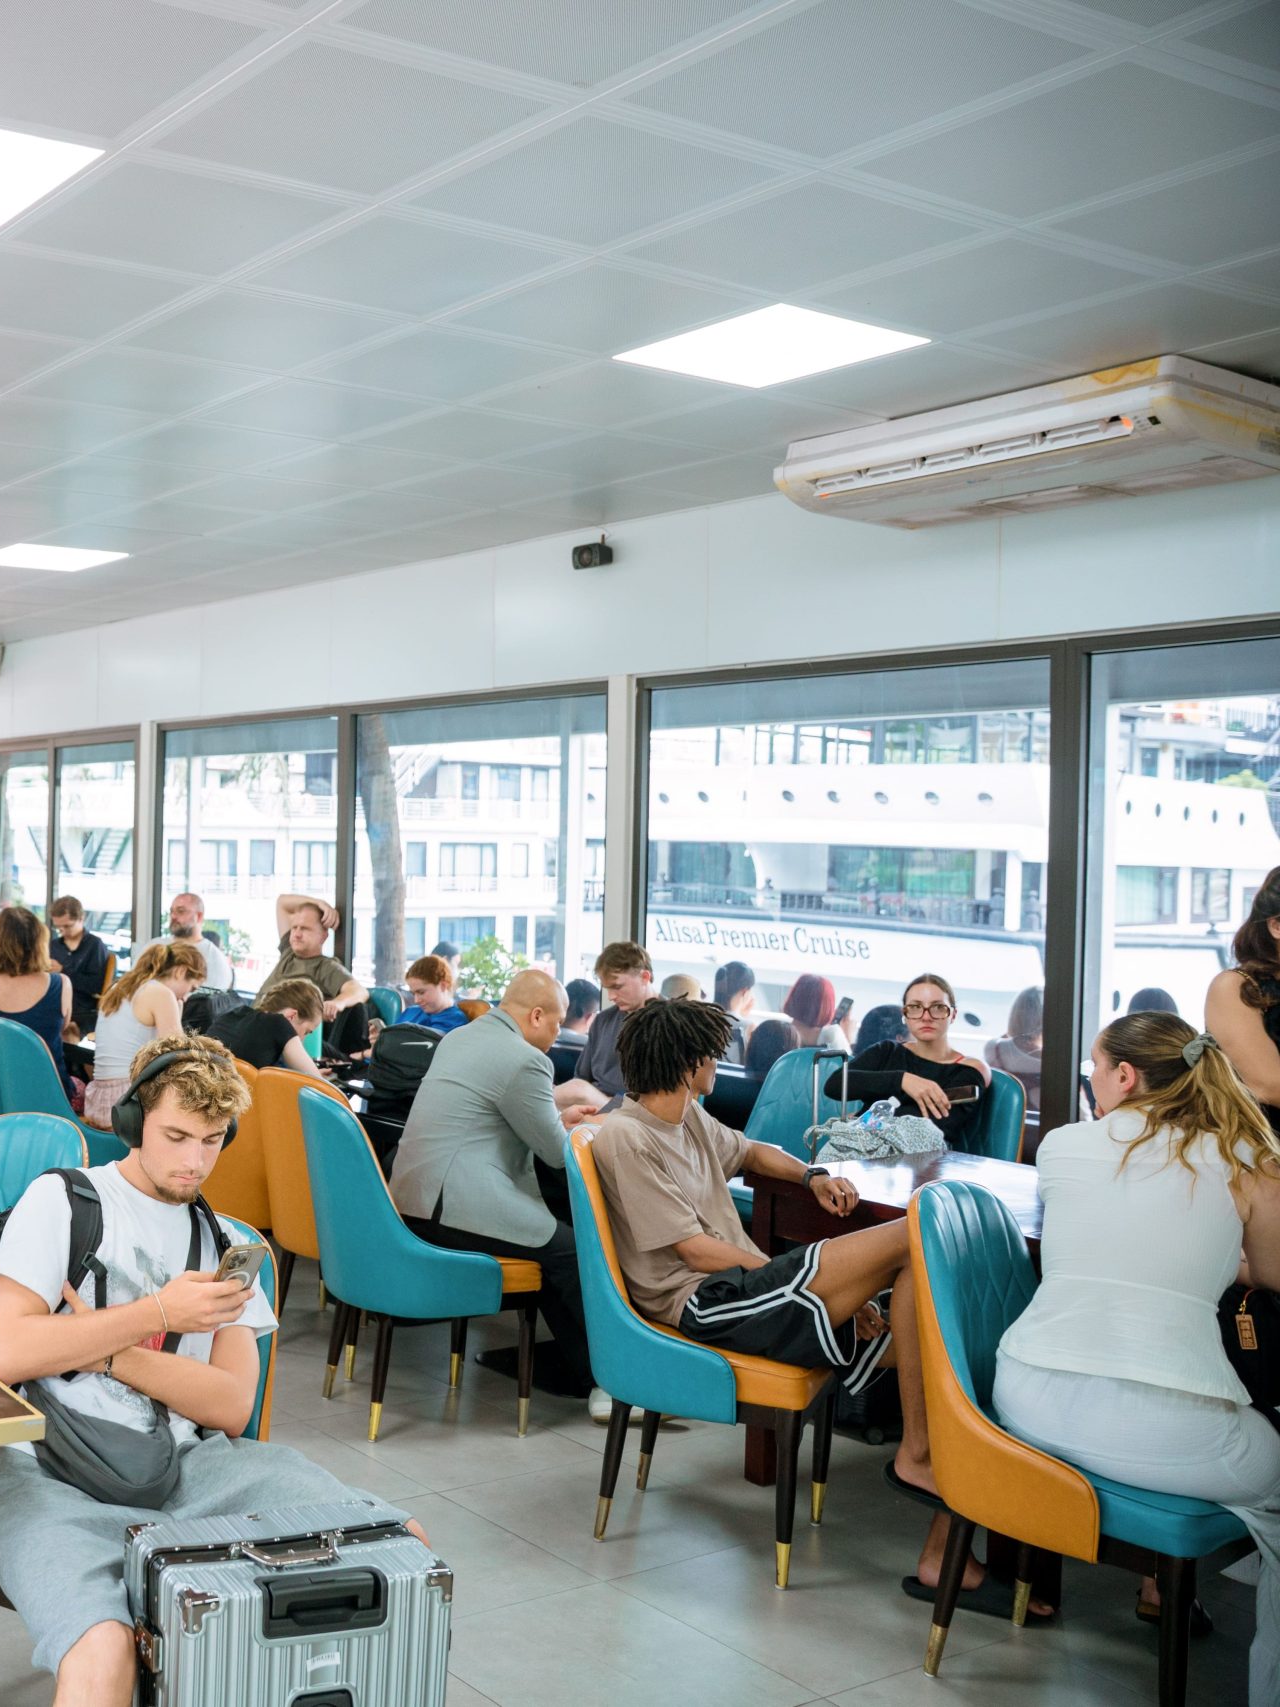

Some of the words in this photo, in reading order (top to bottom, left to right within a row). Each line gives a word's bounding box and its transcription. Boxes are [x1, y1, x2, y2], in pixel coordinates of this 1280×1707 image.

[656, 918, 704, 944] Alisa
[704, 921, 790, 951] Premier
[793, 927, 870, 960] Cruise
